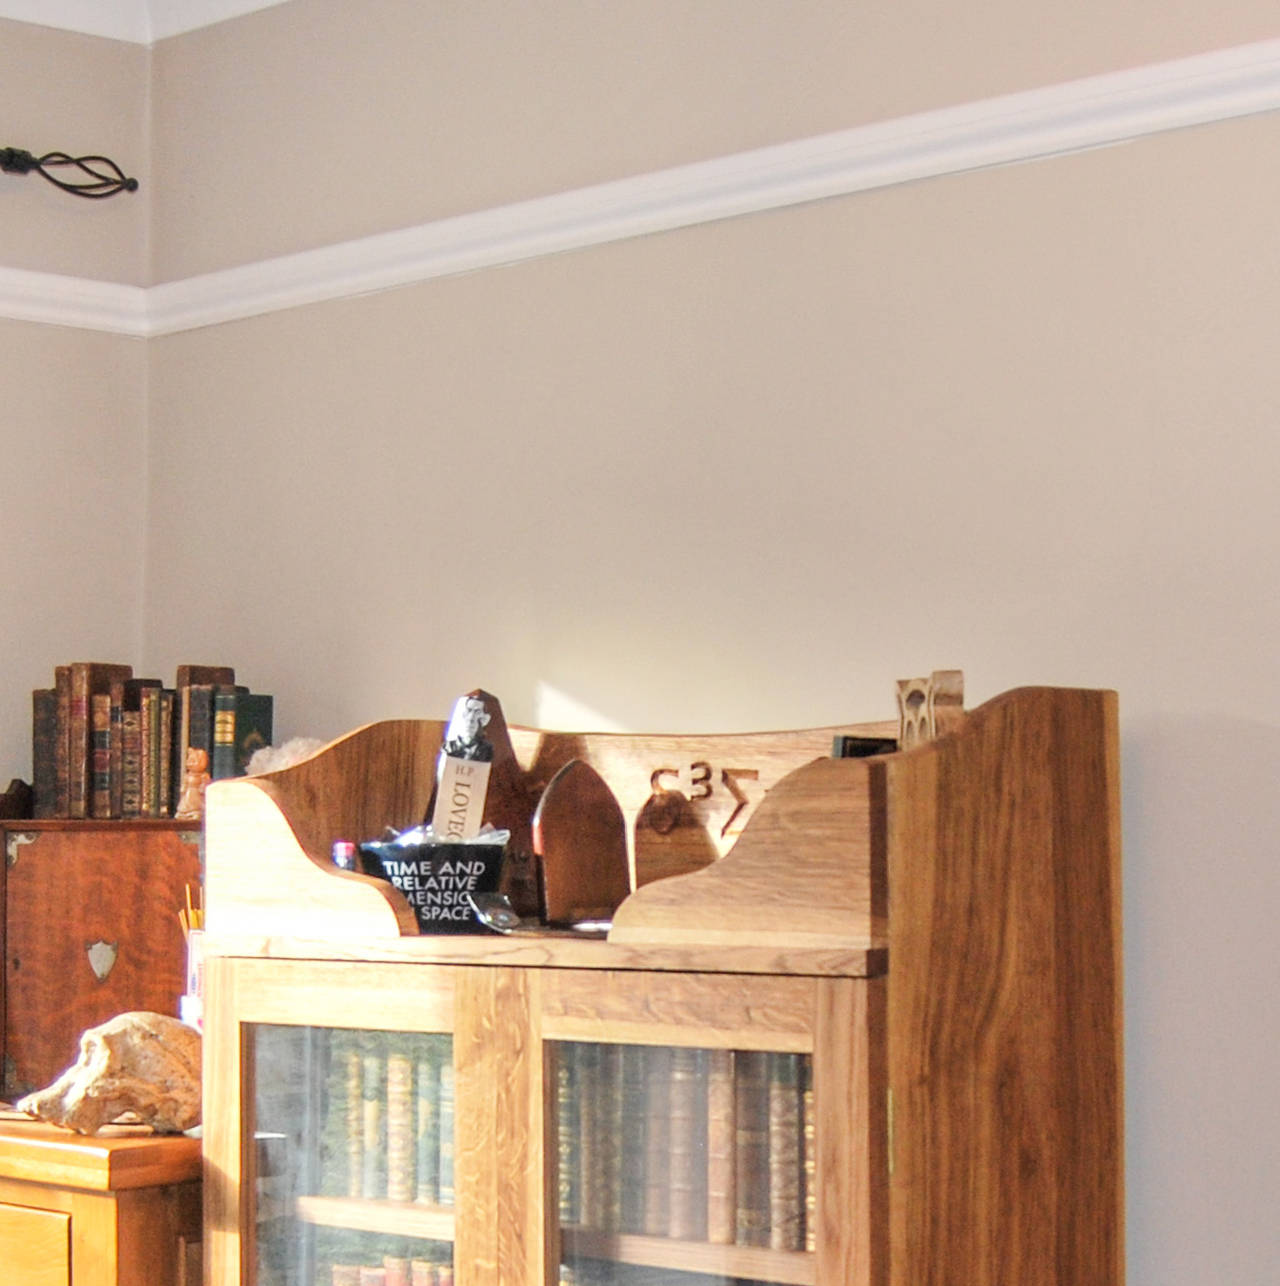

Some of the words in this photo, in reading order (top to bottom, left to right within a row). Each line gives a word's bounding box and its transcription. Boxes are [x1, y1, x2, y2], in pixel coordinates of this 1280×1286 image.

[447, 782, 472, 839] LOVEC
[382, 861, 432, 876] TIME
[439, 861, 486, 876] AND
[391, 876, 478, 891] RELATIVE
[421, 906, 471, 920] SPACE
